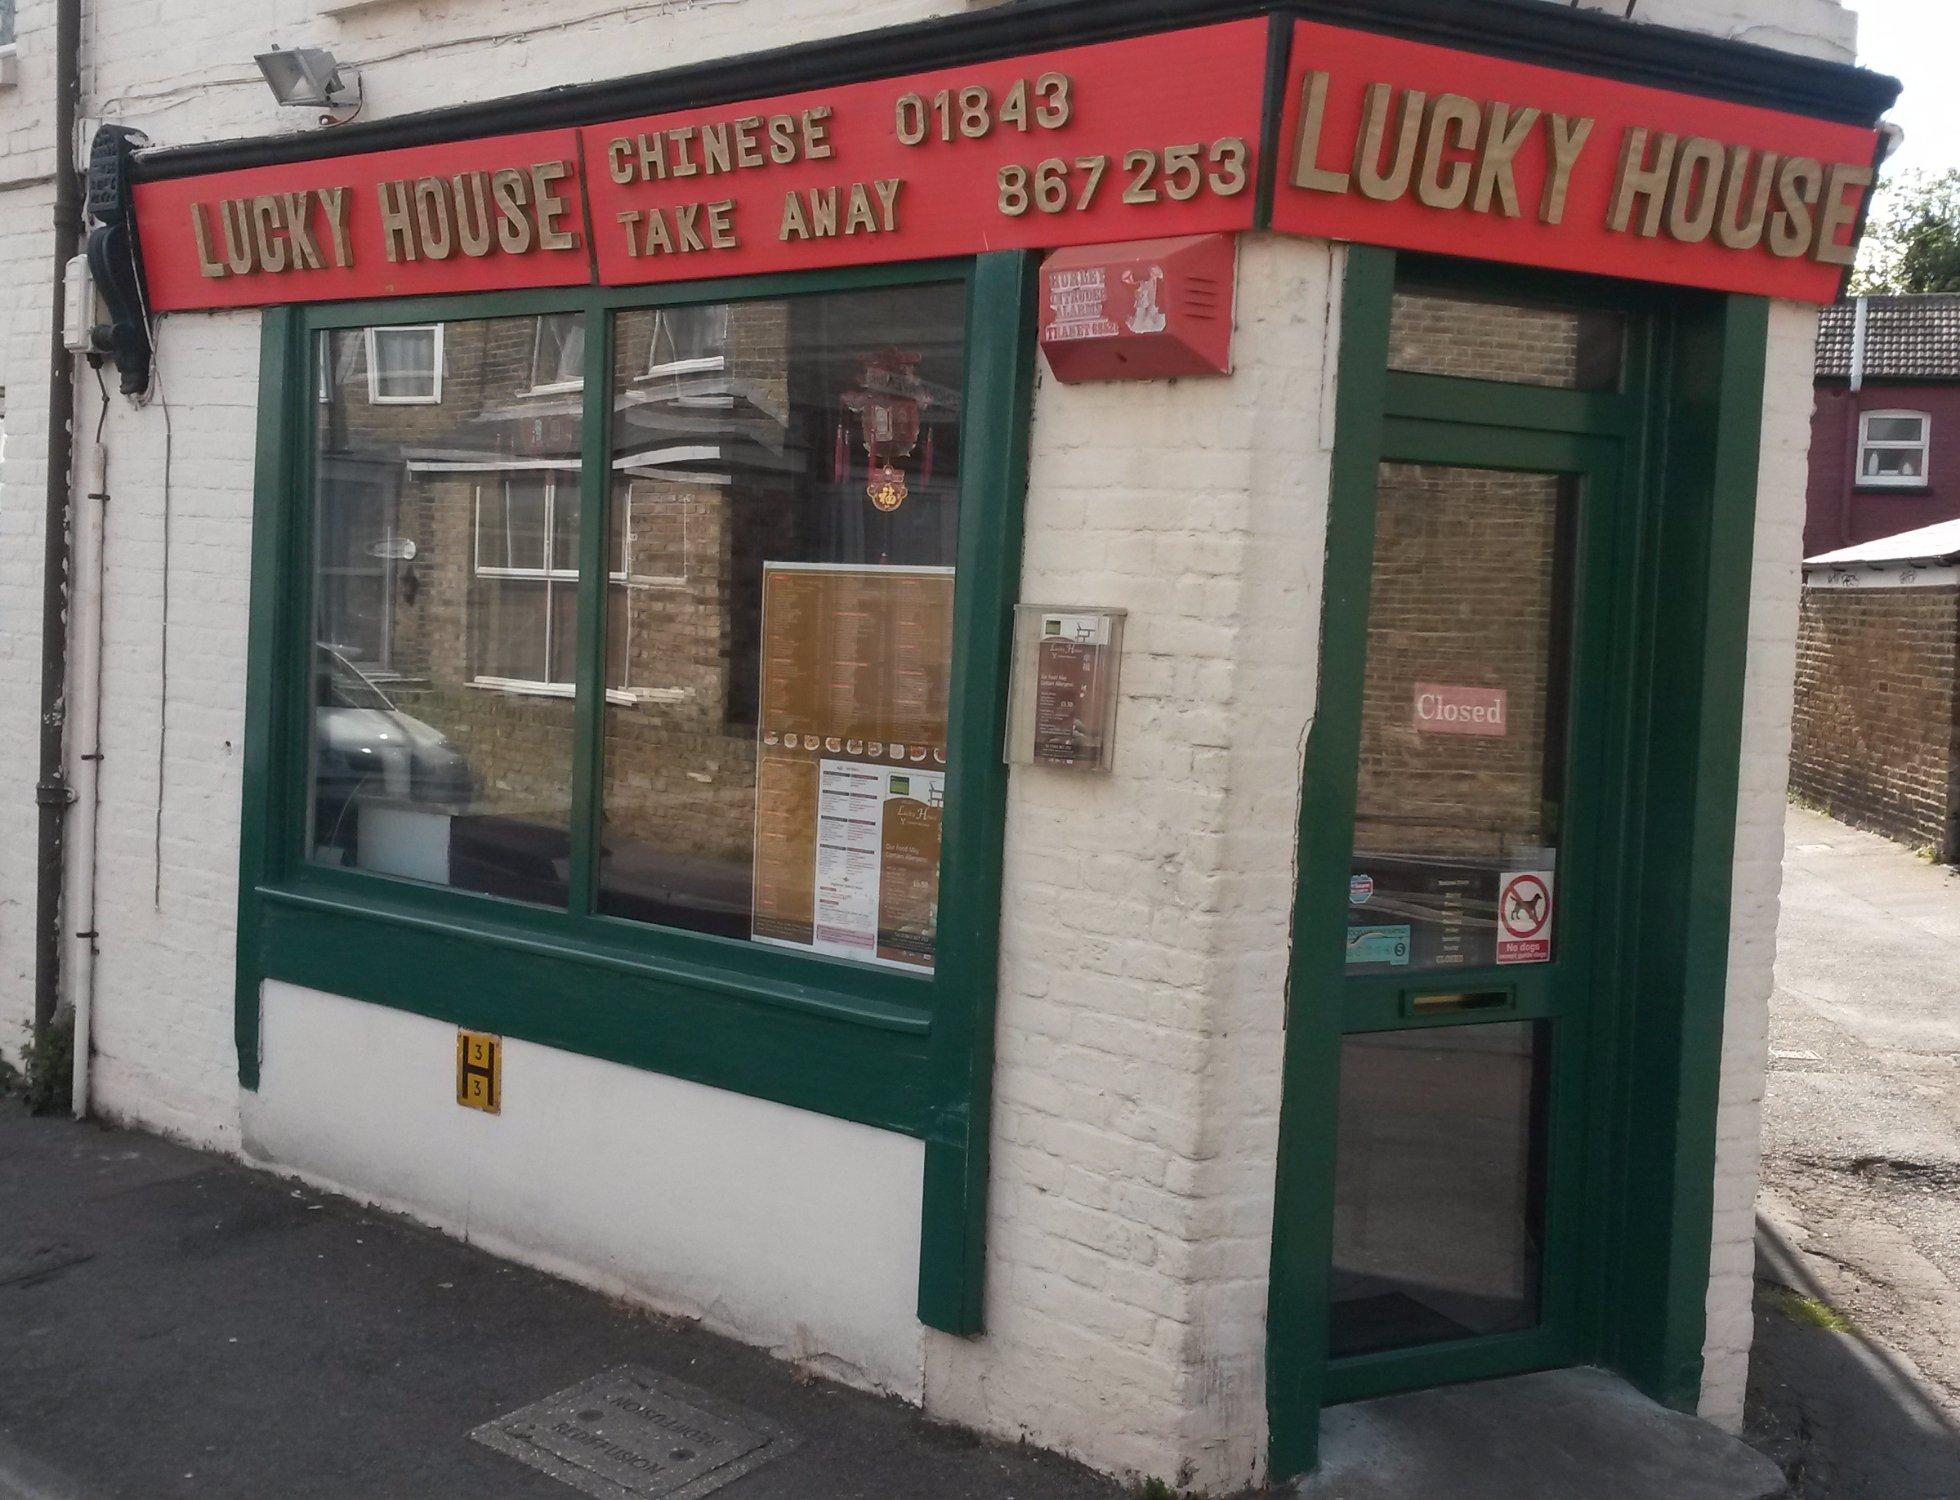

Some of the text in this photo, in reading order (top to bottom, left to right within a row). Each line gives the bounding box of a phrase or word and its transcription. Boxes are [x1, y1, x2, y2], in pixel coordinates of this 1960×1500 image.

[607, 105, 836, 185] CHINESE
[894, 71, 1073, 147] 01843
[996, 136, 1248, 218] 867 253
[1291, 69, 1874, 266] LUCKY HOUSE
[190, 159, 581, 278] LUCKY HOUSE
[616, 177, 906, 258] TAKE AWAY
[1416, 693, 1503, 724] Closed
[1506, 943, 1541, 953] No dogs
[473, 1080, 481, 1096] 3
[475, 1045, 482, 1060] 3
